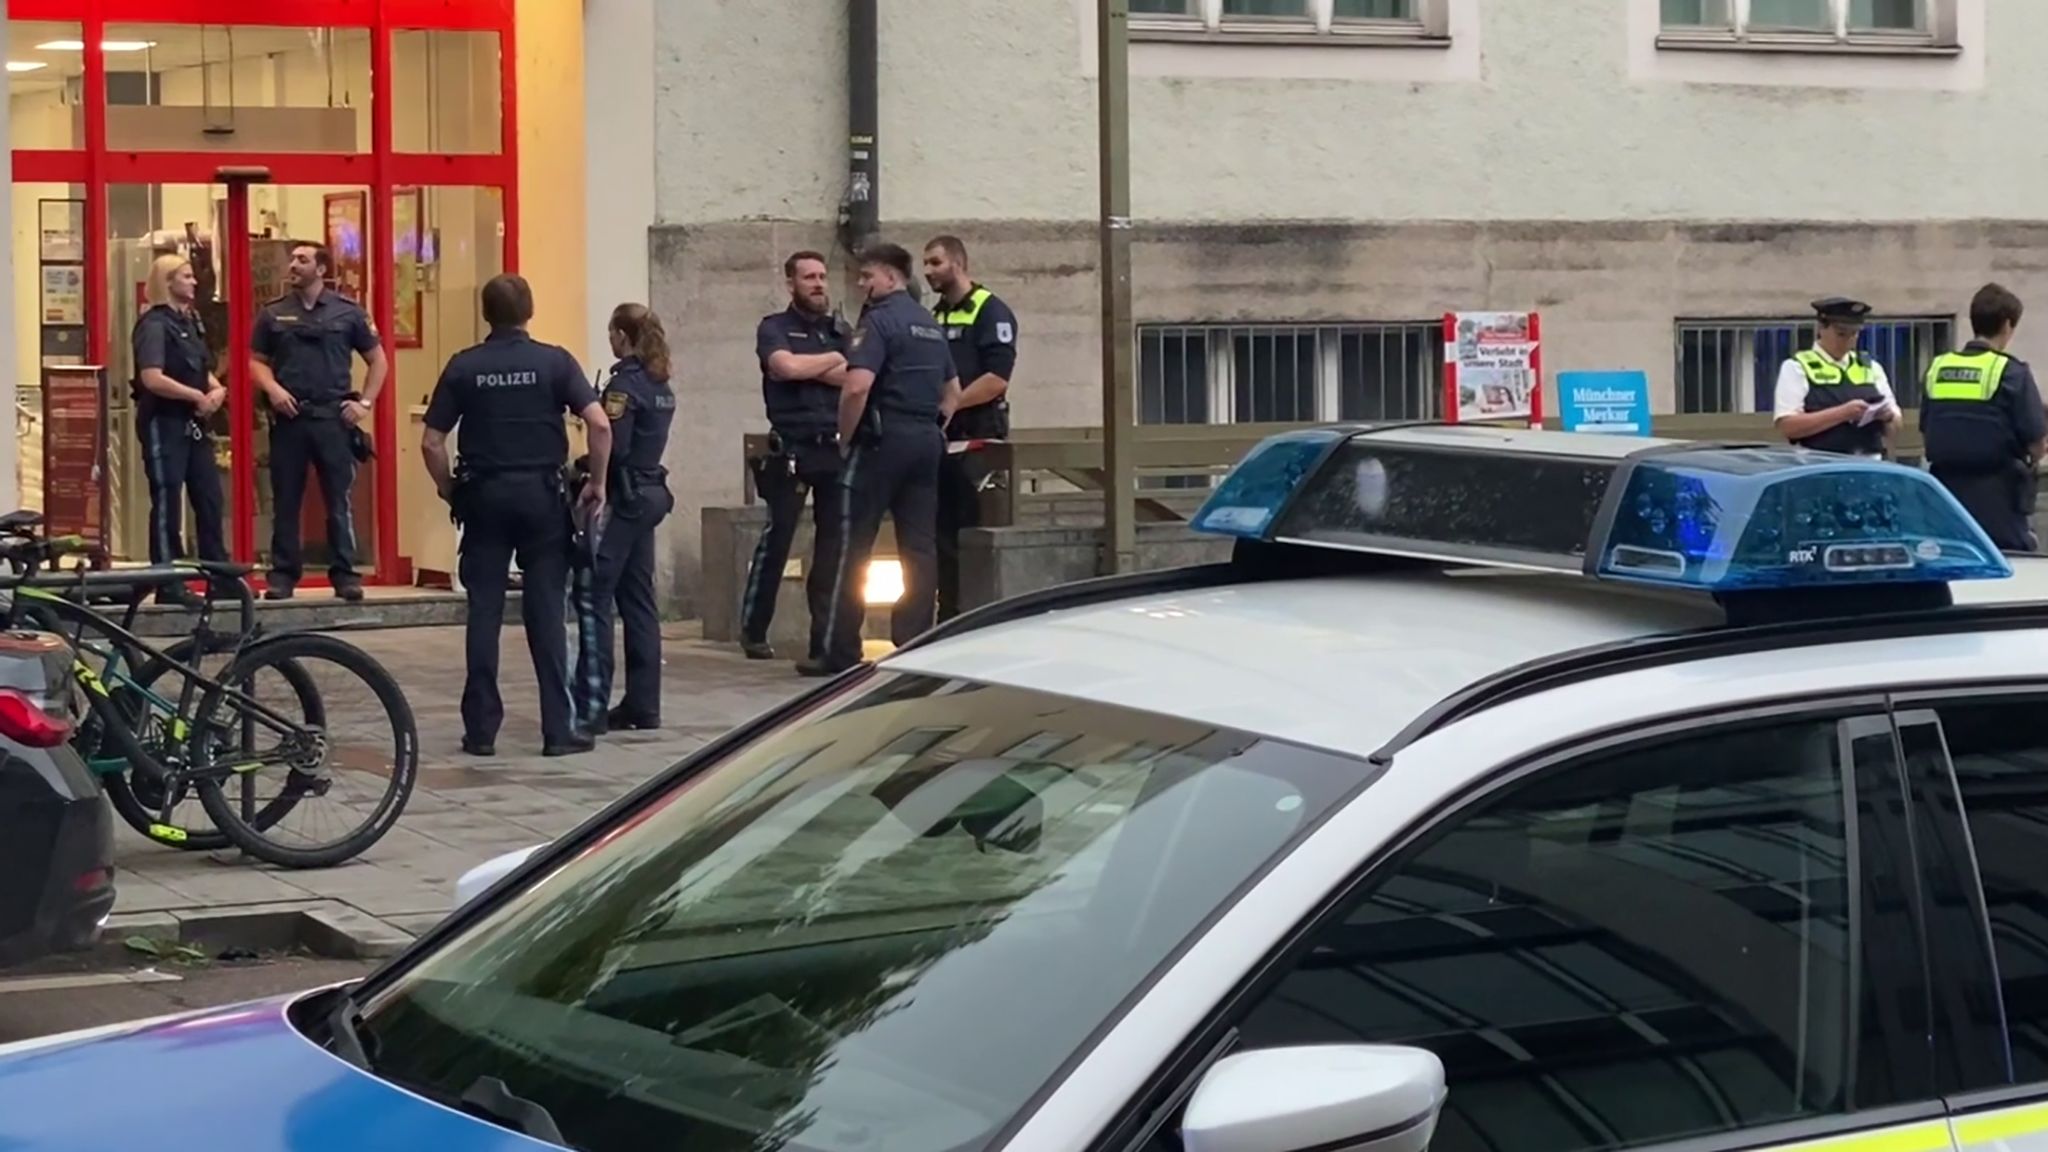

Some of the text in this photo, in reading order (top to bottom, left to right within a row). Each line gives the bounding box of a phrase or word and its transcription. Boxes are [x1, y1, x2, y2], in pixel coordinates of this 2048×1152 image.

[1463, 358, 1523, 368] unsere Stadt
[476, 371, 537, 388] POLIZEI
[1572, 387, 1636, 403] Münchner
[1583, 407, 1630, 422] Merkur
